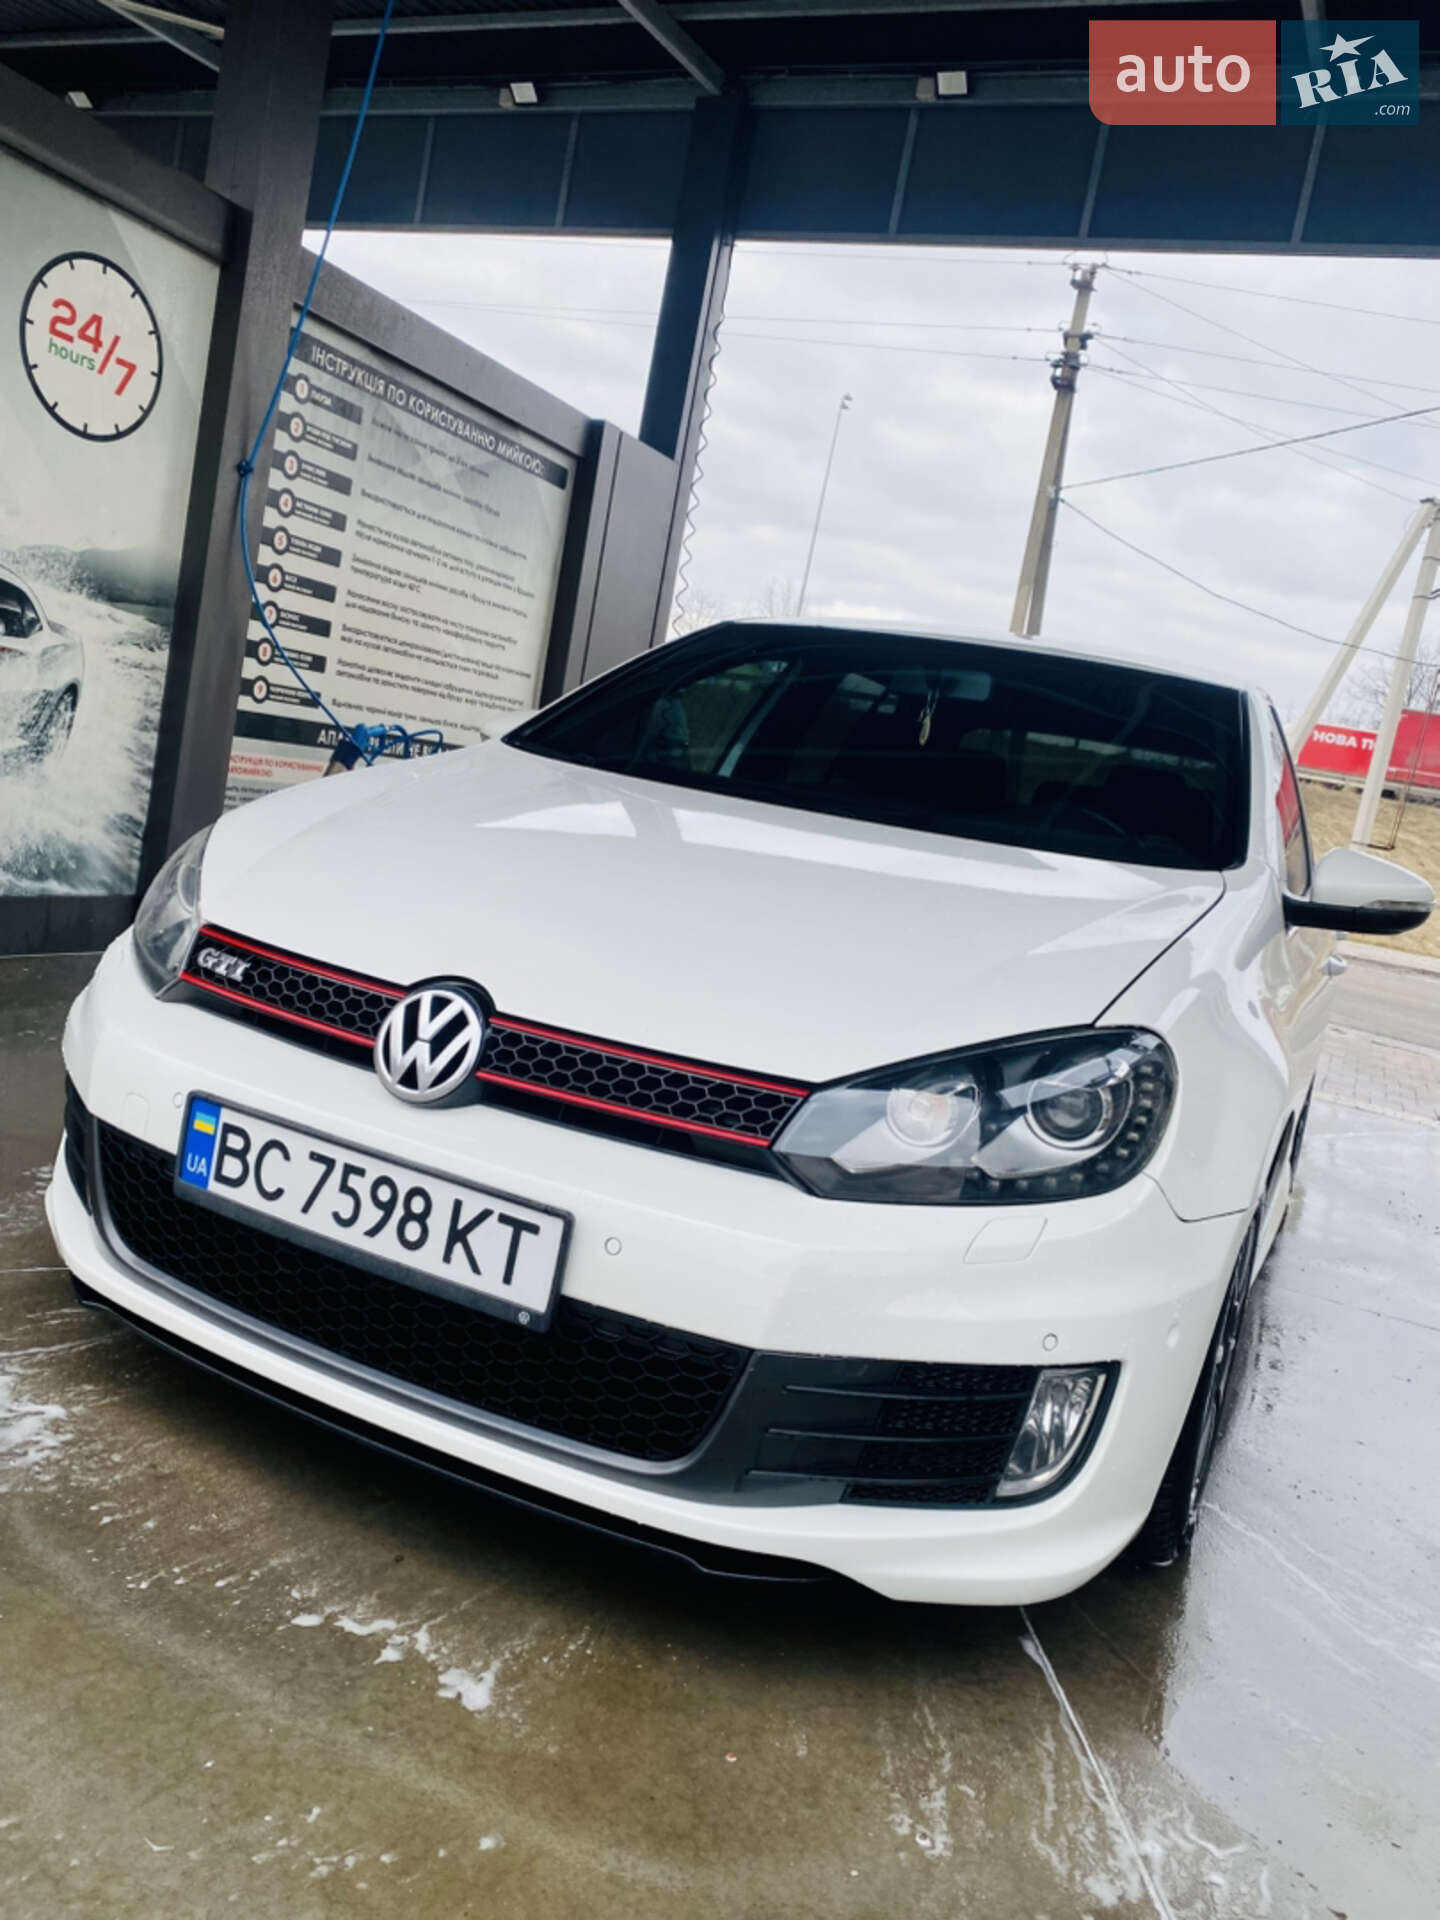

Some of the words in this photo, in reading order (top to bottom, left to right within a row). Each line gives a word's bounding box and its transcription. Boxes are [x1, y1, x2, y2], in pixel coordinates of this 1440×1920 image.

[48, 338, 96, 371] hours
[49, 298, 137, 396] 24/7
[311, 345, 385, 397] ІНСТРУКЦІЯ
[386, 382, 407, 408] ПО
[408, 393, 495, 451] КОРИСТУВАННЮ
[1312, 729, 1357, 748] НОВА
[197, 946, 251, 981] GTI
[186, 1153, 208, 1177] UA
[213, 1121, 291, 1202] BC
[301, 1150, 433, 1251] 7598
[442, 1197, 541, 1286] KT
